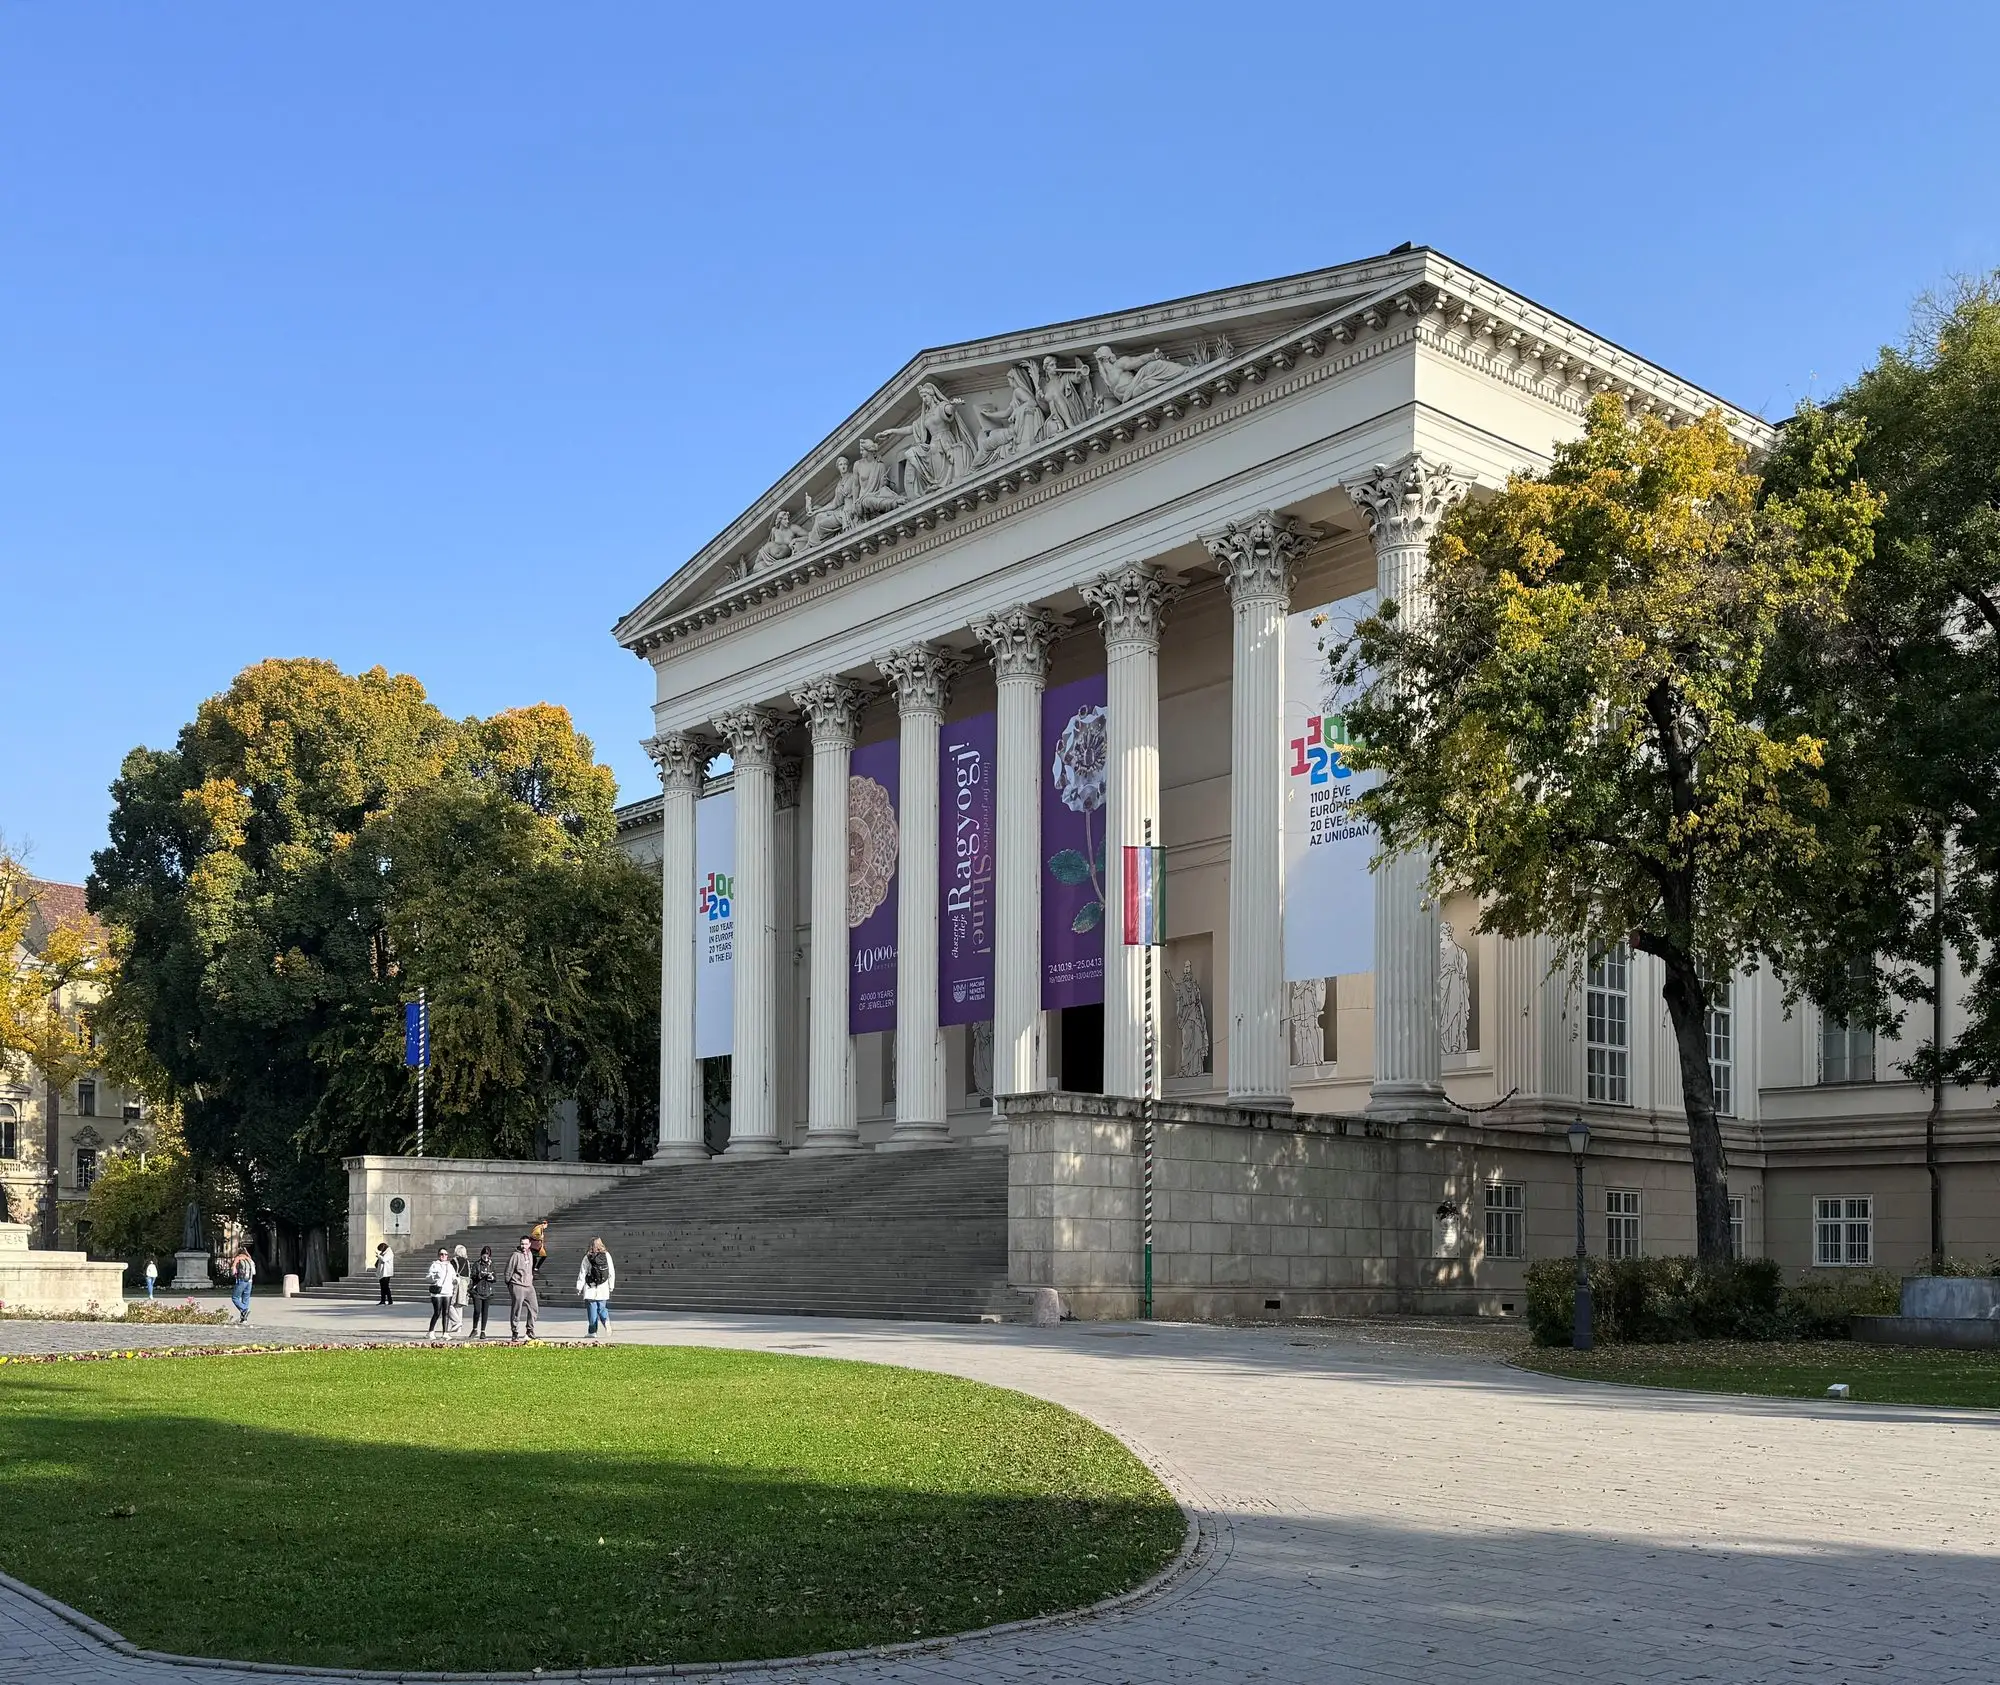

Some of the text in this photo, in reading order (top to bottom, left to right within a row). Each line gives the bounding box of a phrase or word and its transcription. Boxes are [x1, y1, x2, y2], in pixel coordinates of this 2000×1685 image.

[1310, 785, 1351, 803] 1100 ÉVE
[948, 742, 980, 916] Ragyogj!
[1310, 816, 1342, 832] 20 ÉVE
[1310, 826, 1369, 847] AZ UNIÓBAN
[972, 855, 992, 954] Shine!
[877, 989, 894, 999] YEARS
